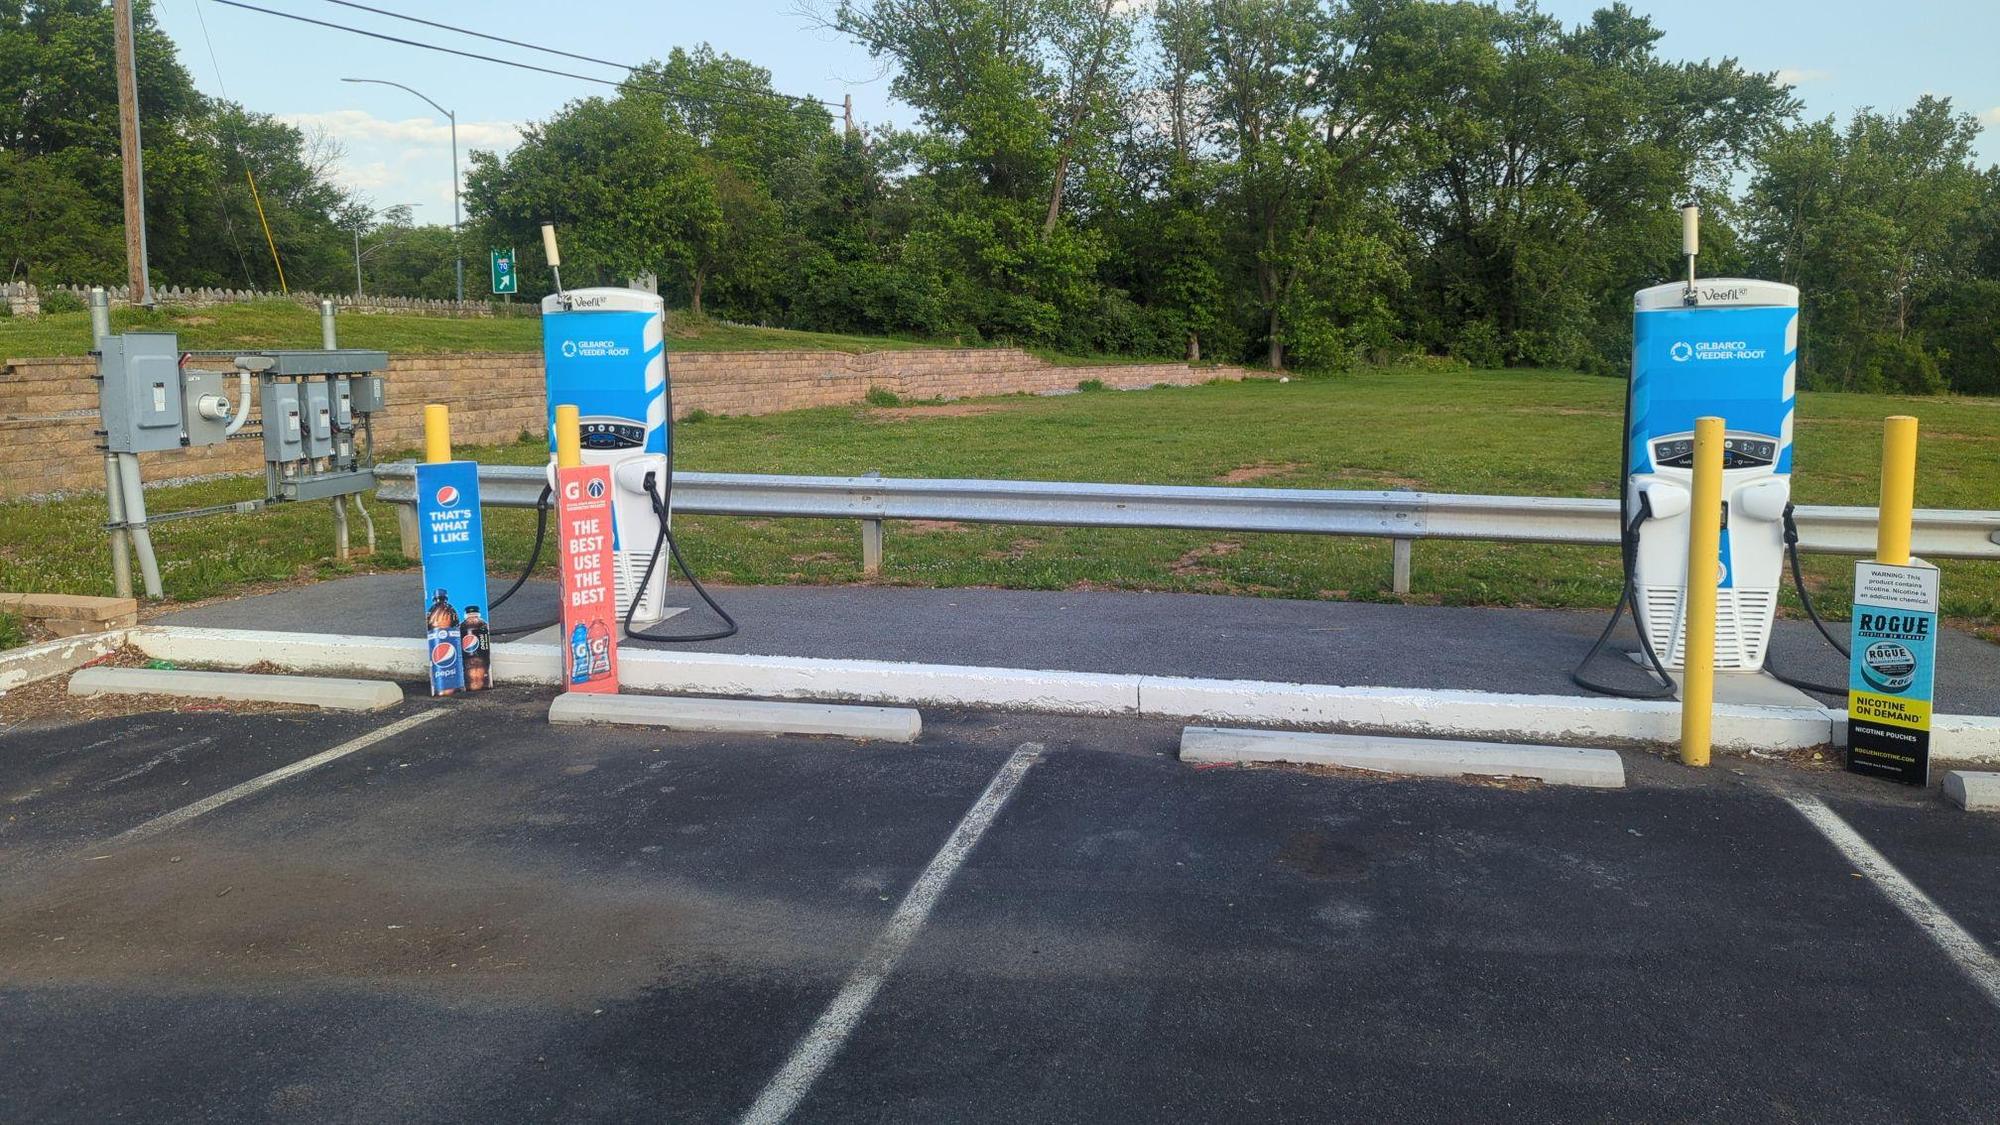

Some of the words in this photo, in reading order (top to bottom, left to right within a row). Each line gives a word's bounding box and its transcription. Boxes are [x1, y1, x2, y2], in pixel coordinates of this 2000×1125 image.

[499, 262, 508, 270] 70
[1702, 288, 1740, 301] Veefil
[574, 296, 601, 307] Veefil
[578, 340, 614, 348] GILBARCO
[1695, 341, 1746, 350] GILBARCO
[578, 348, 629, 356] VEEDER-ROOT
[1695, 350, 1766, 360] VEEDER-ROOT
[565, 481, 580, 500] G
[429, 509, 472, 521] THAT'S
[432, 521, 469, 532] WHAT
[572, 518, 599, 535] THE
[433, 534, 439, 544] I
[441, 532, 470, 543] LIKE
[569, 535, 604, 554] BEST
[574, 554, 600, 570] USE
[575, 571, 601, 588] THE
[1871, 570, 1905, 579] WARNING:
[1907, 573, 1921, 581] This
[1895, 581, 1923, 589] contains
[572, 588, 606, 606] BEST
[1869, 593, 1898, 602] addictive
[1892, 588, 1919, 596] Nicotine
[1859, 614, 1929, 634] ROGUE
[1868, 649, 1907, 658] ROGUE
[434, 669, 457, 678] pepsi
[1856, 696, 1906, 712] NICOTINE
[1856, 705, 1871, 716] ON
[1855, 727, 1885, 736] NICOTINE
[1886, 732, 1917, 742] POUCHES
[1854, 747, 1915, 762] ROGUENICOTINE.COM
